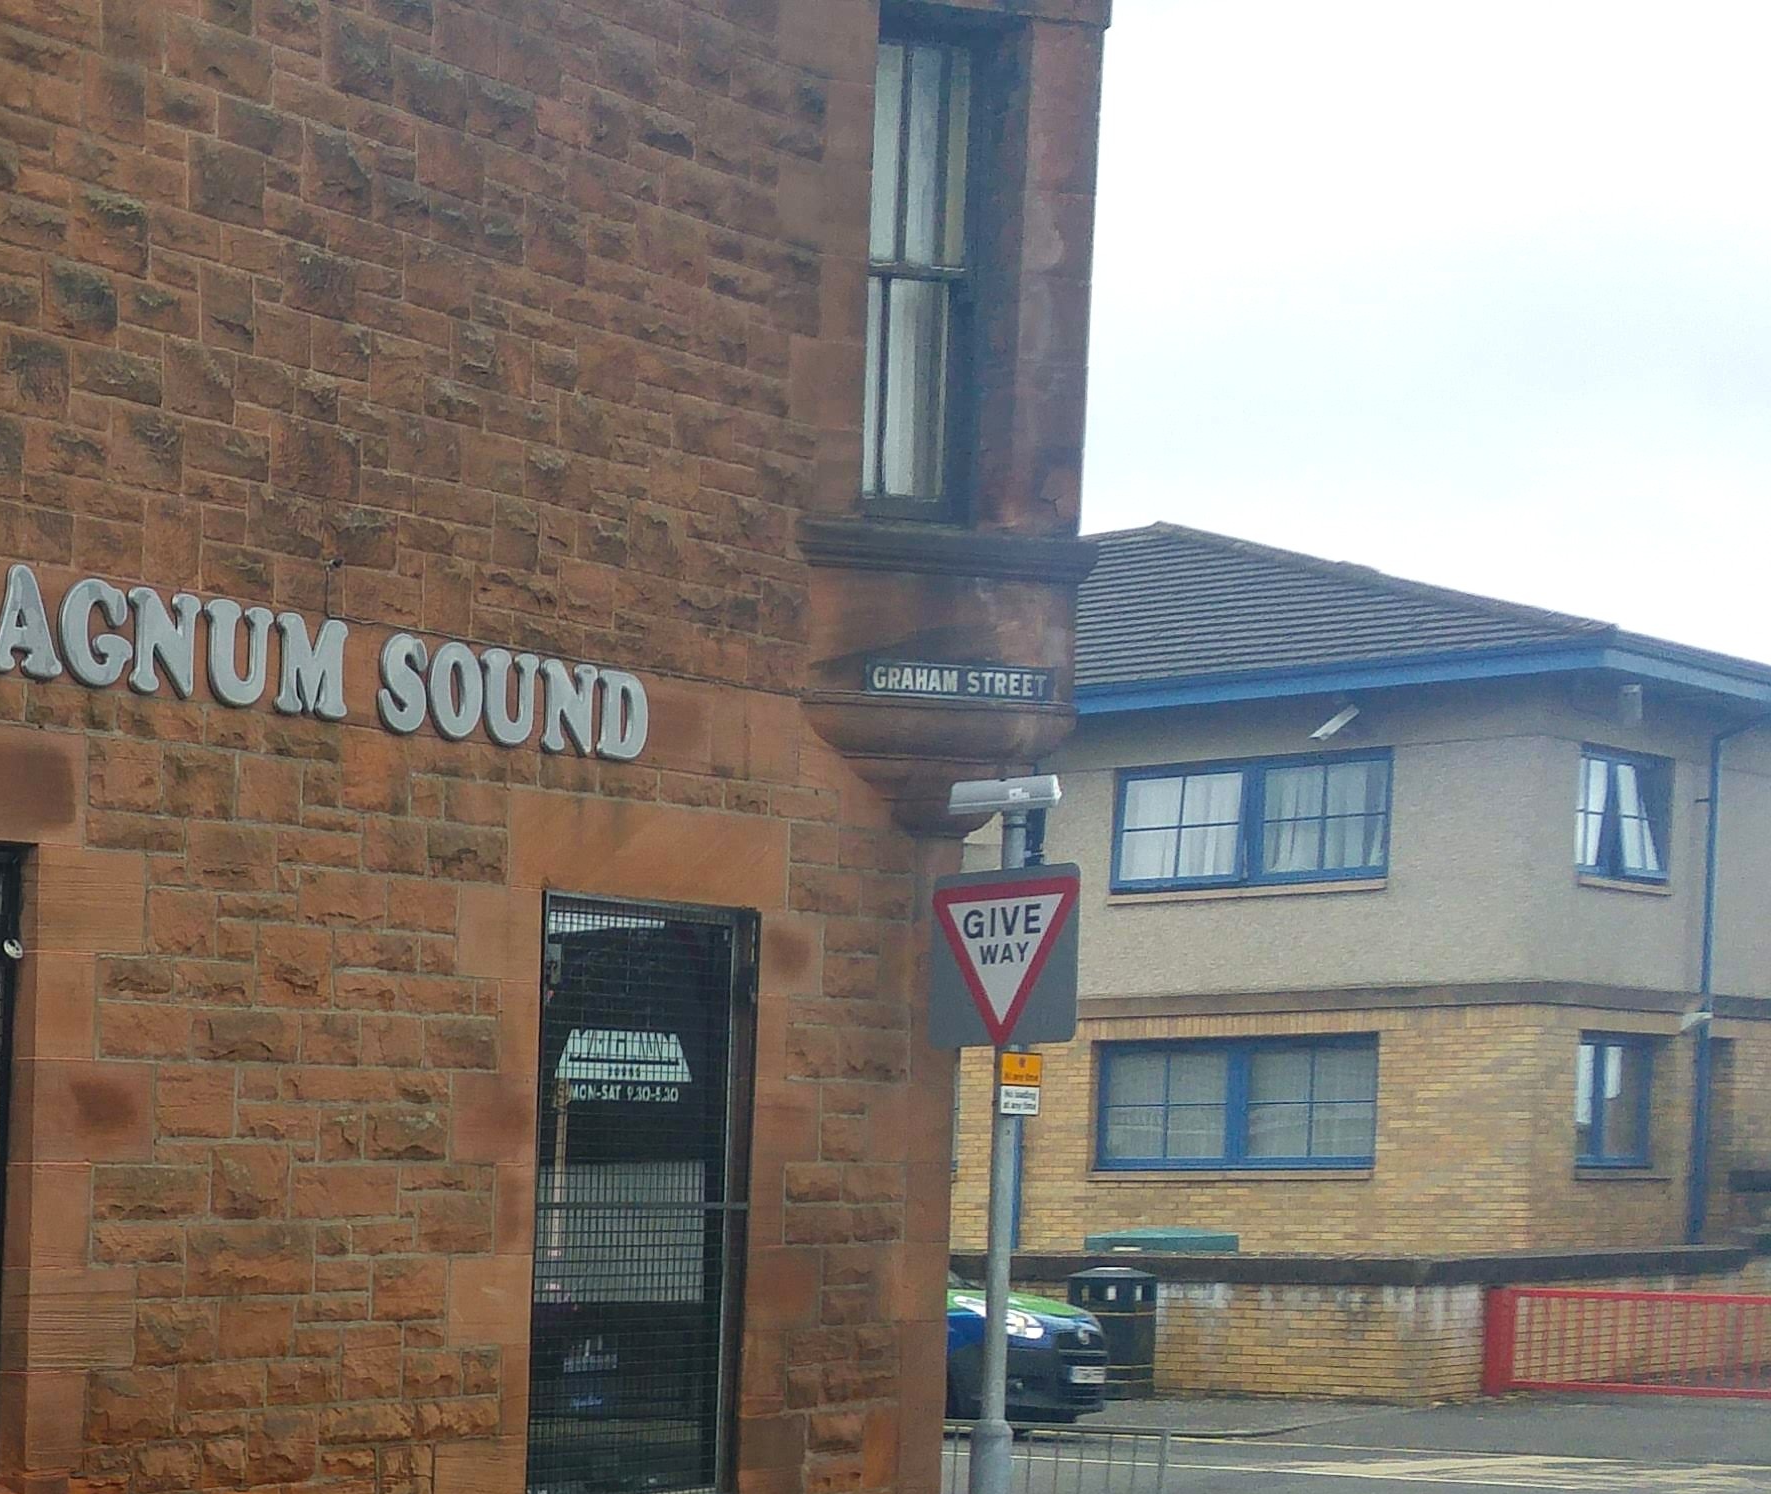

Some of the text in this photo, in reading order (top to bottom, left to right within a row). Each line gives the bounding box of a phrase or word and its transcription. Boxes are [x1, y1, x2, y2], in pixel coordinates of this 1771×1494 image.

[379, 631, 649, 761] SOUND
[873, 665, 1047, 697] GRAHAM STREET
[963, 903, 1041, 939] GIVE
[980, 941, 1029, 965] WAY
[570, 1083, 621, 1101] MON-SAT
